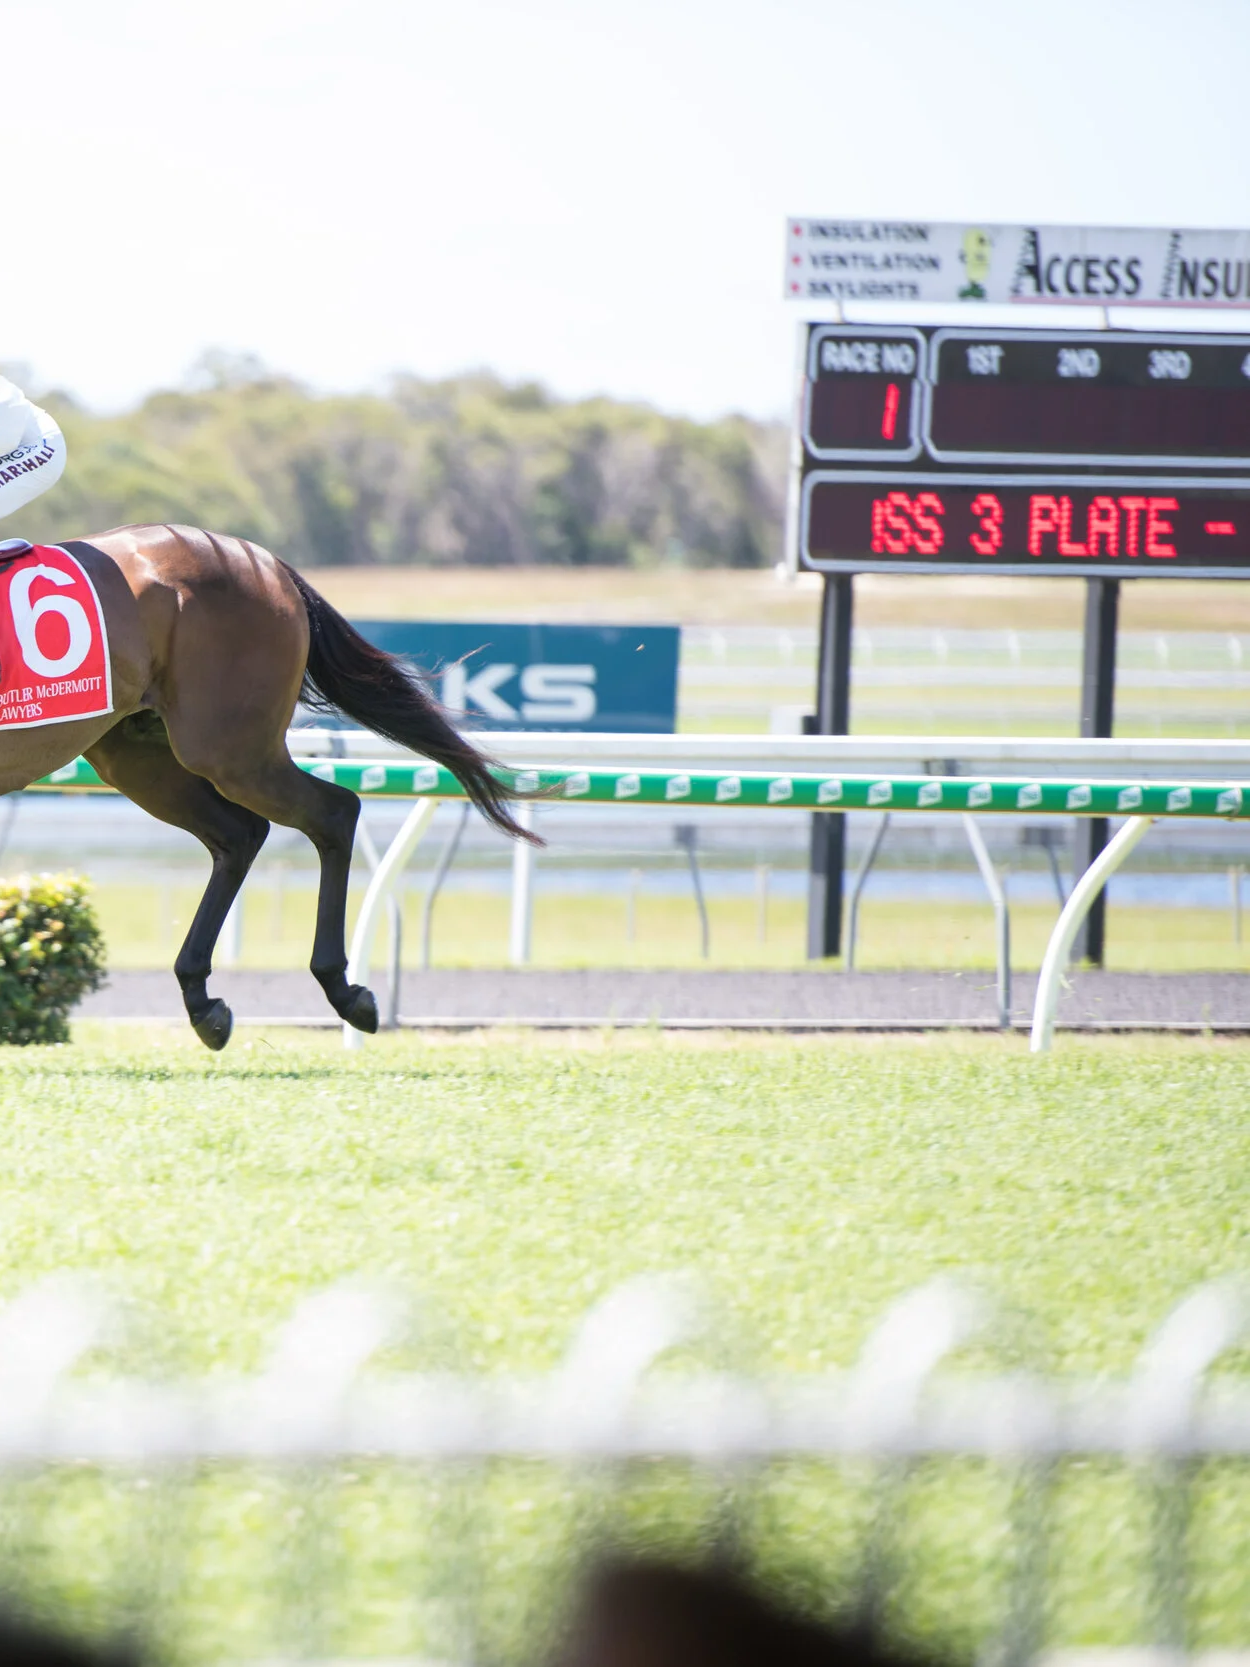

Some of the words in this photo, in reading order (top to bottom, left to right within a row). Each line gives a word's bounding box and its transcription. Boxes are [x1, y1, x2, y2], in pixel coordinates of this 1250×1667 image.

[1160, 230, 1250, 299] INSU
[965, 344, 1005, 376] 1ST
[1057, 348, 1101, 378] 2ND
[1148, 349, 1192, 380] 3RD
[881, 382, 900, 440] 1
[968, 493, 1004, 556] 3
[1028, 495, 1180, 558] PLATE
[9, 563, 92, 678] 6
[36, 676, 102, 699] McDERMOTT
